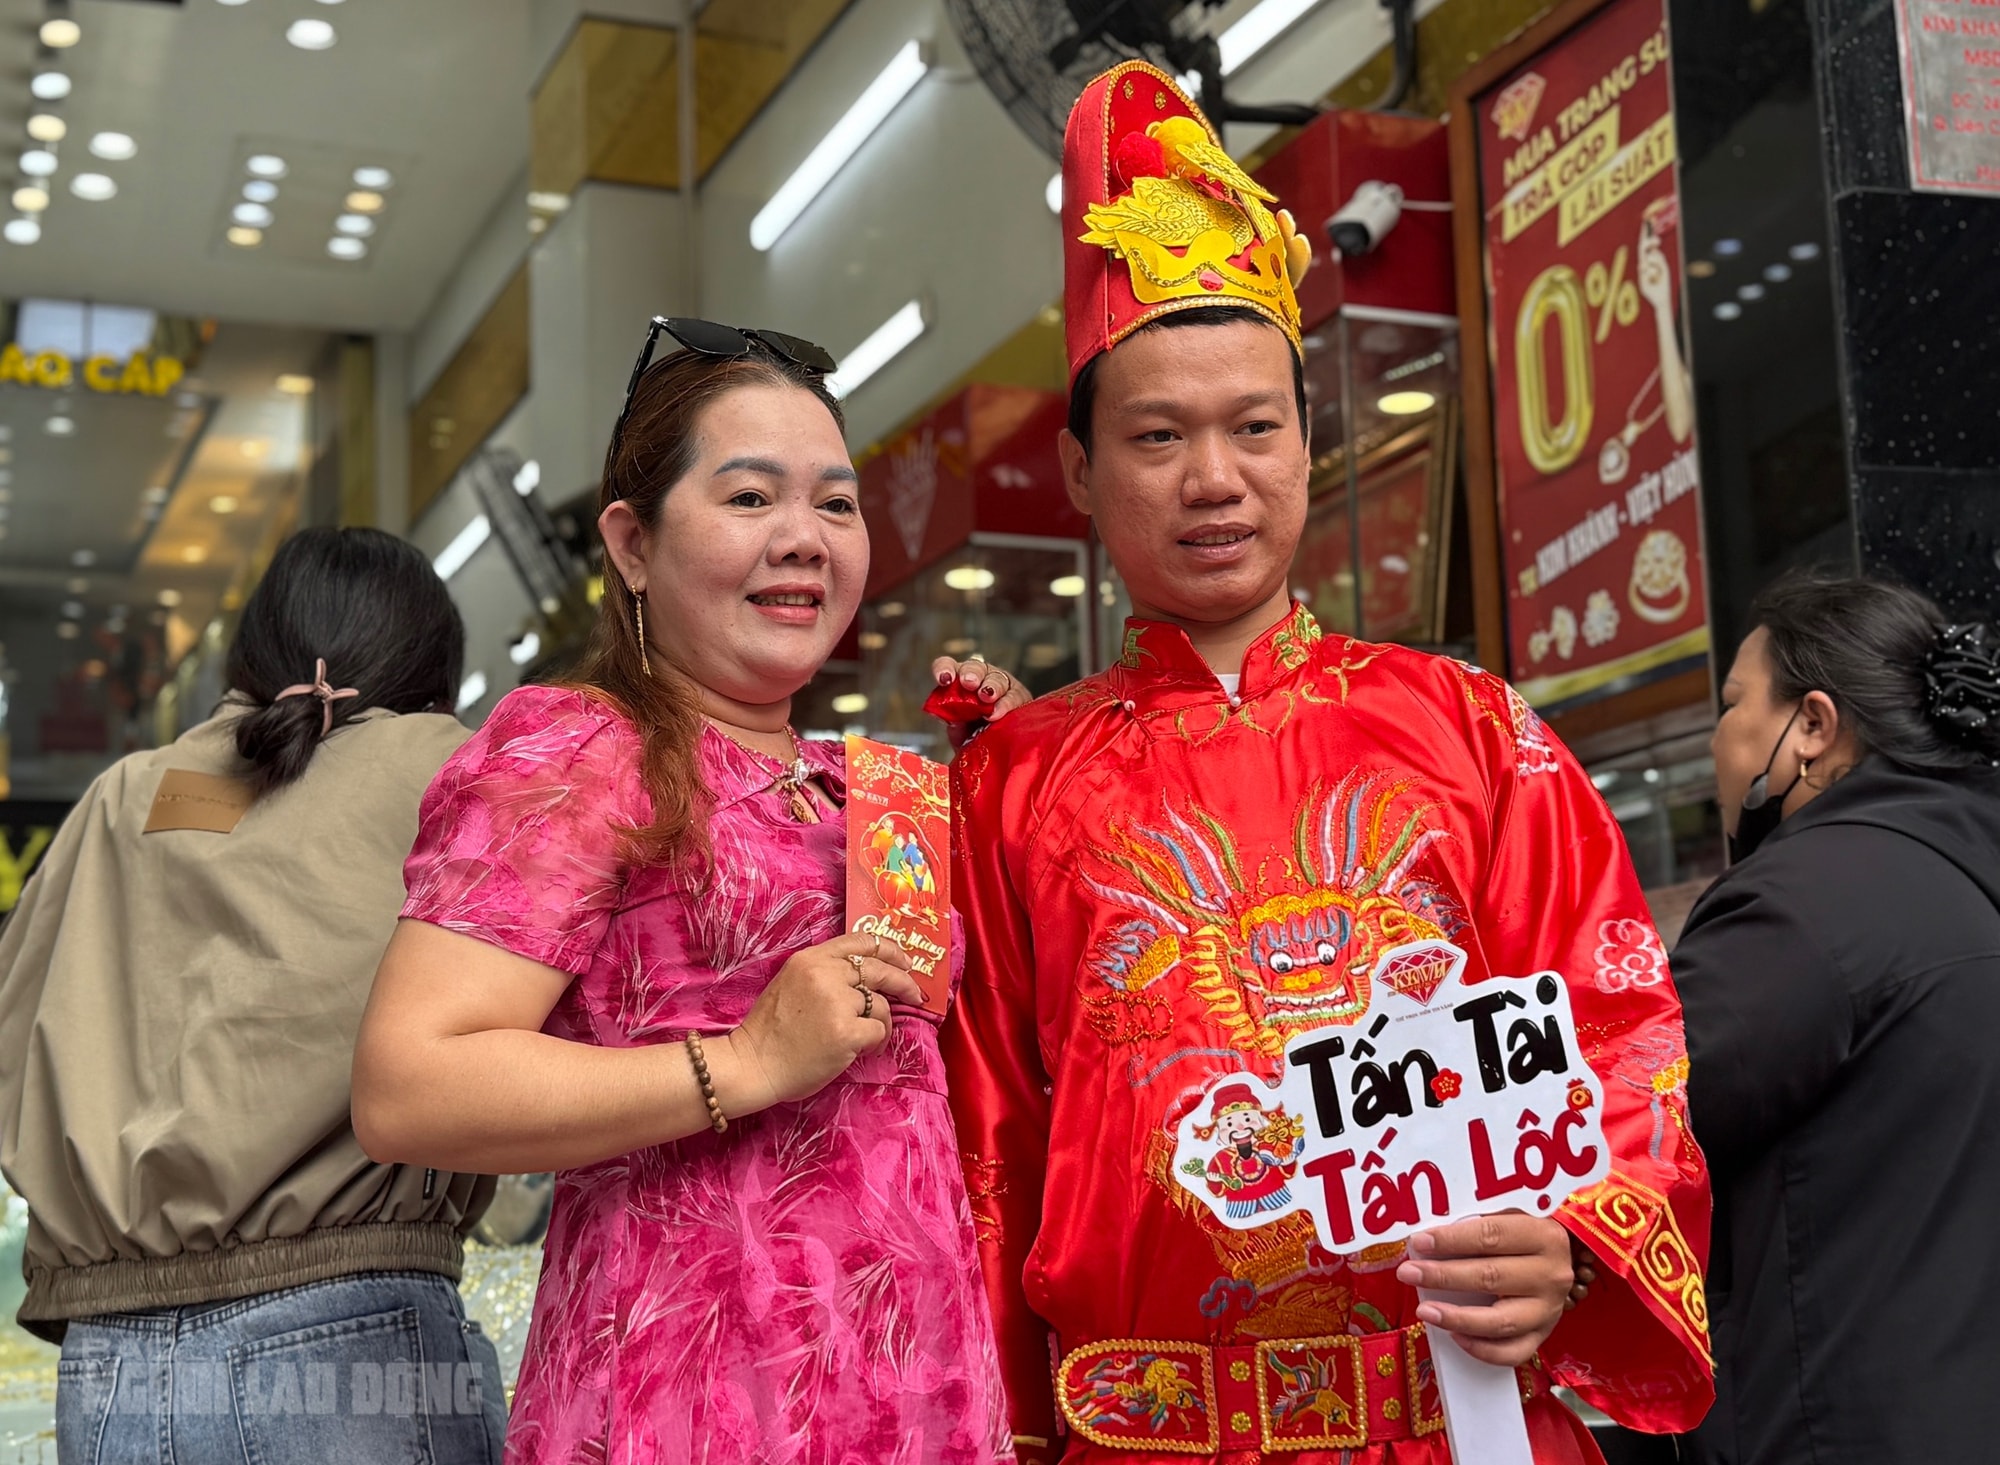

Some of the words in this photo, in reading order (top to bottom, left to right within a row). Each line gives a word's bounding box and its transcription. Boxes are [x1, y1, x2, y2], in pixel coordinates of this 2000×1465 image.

[1503, 126, 1556, 187] MUA
[1556, 54, 1637, 142] TRANG
[1289, 1014, 1444, 1138] Tấn
[1453, 975, 1568, 1093] Tài
[1303, 1127, 1450, 1245] Tấn
